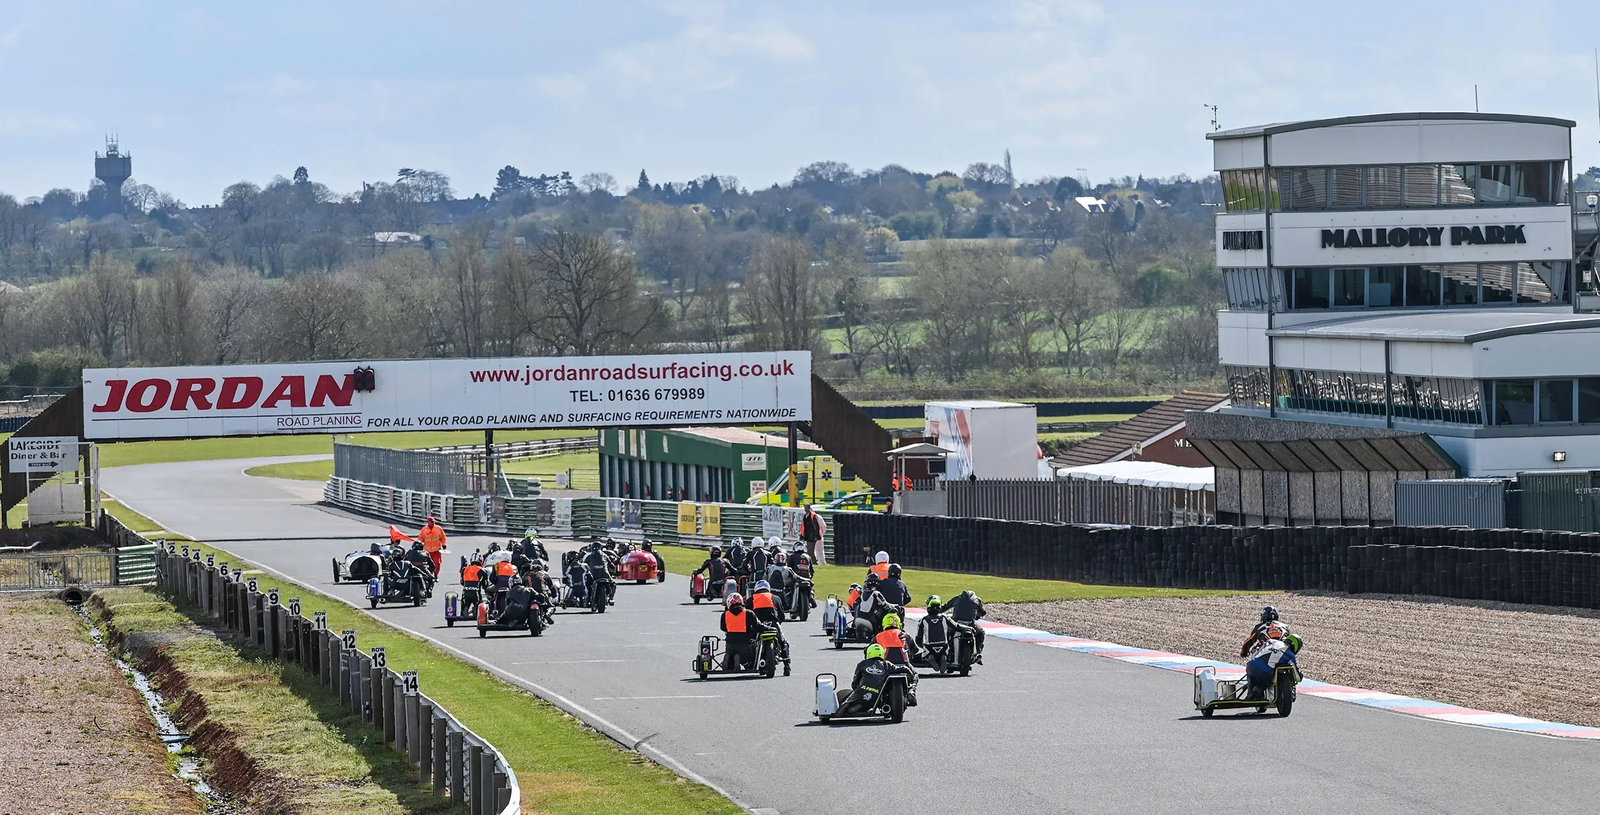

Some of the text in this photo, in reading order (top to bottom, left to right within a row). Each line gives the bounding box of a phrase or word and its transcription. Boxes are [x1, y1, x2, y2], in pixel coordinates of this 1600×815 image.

[1321, 224, 1527, 249] MALLORY PARK
[470, 359, 795, 386] www.jordanroadsurfacing.co.uk
[92, 373, 356, 413] JORDAN
[569, 387, 705, 403] TEL: 01636 679989
[277, 415, 362, 427] ROAD PLANING
[367, 408, 797, 428] FOR ALL YOUR ROAD PLANING AND SURFACING REQUIREMENTS NATIONWIDE
[10, 452, 38, 460] Diner
[40, 451, 48, 459] &
[159, 540, 164, 549] 1
[169, 545, 176, 554] 2
[182, 547, 189, 557] 3
[193, 552, 200, 561] 4
[207, 557, 214, 566] 5
[220, 565, 228, 576] 6
[233, 572, 241, 582] 7
[249, 581, 257, 592] 8
[269, 592, 279, 605] 9
[289, 602, 301, 616] 10
[315, 616, 327, 629] 11
[343, 635, 356, 649] 12
[372, 652, 386, 668] 13
[403, 676, 418, 693] 14
